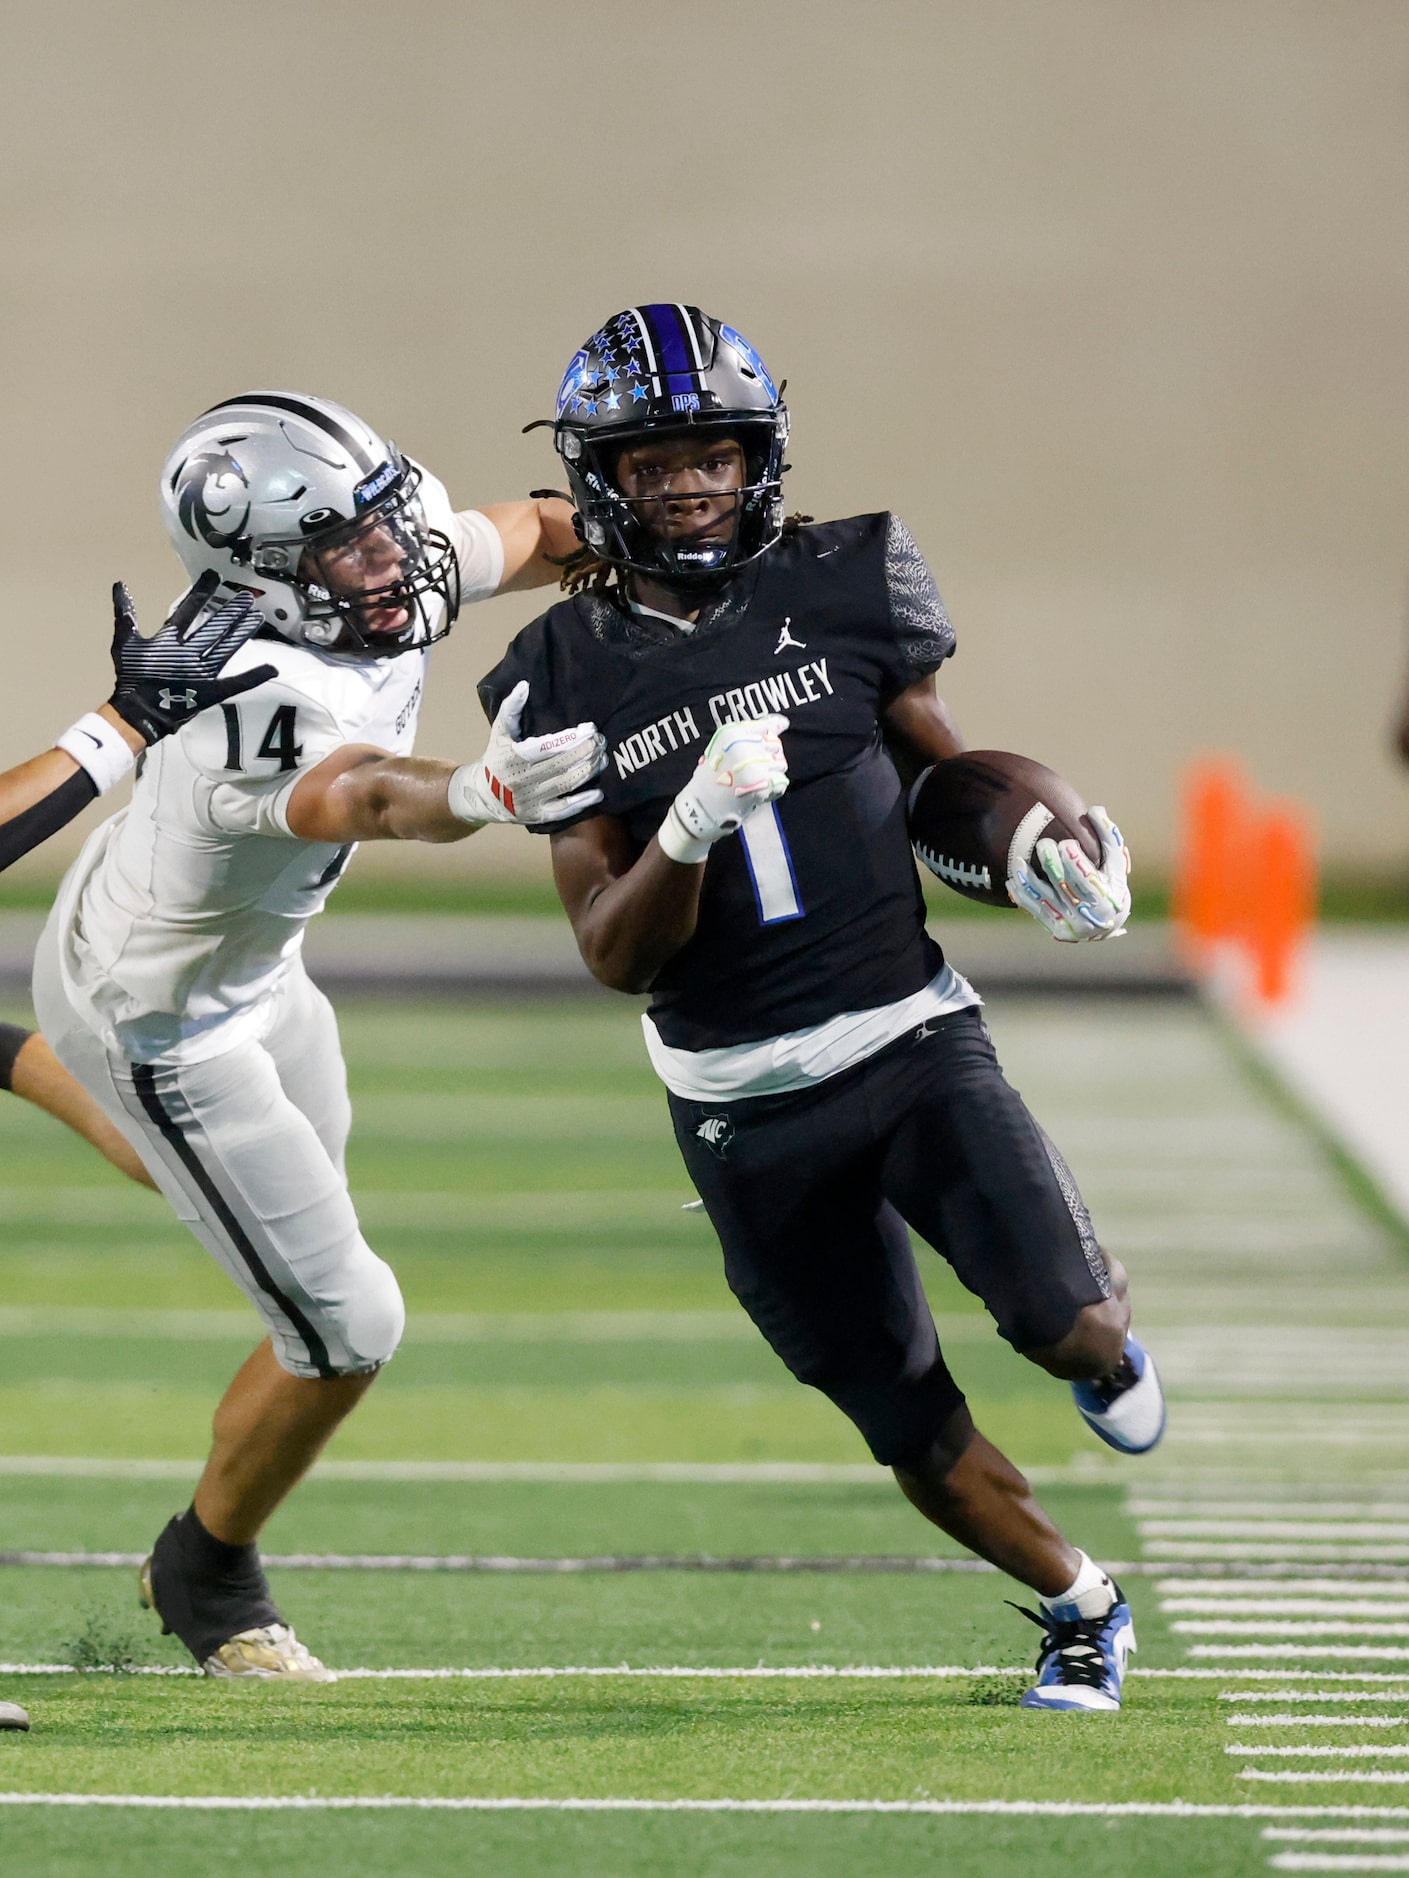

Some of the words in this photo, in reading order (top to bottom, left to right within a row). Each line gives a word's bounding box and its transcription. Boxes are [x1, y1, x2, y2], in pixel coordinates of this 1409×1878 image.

[219, 703, 304, 773] 14
[539, 732, 577, 752] ADIZERO
[612, 706, 701, 781] NORTH
[708, 657, 834, 729] CROWLEY
[737, 800, 806, 926] 1
